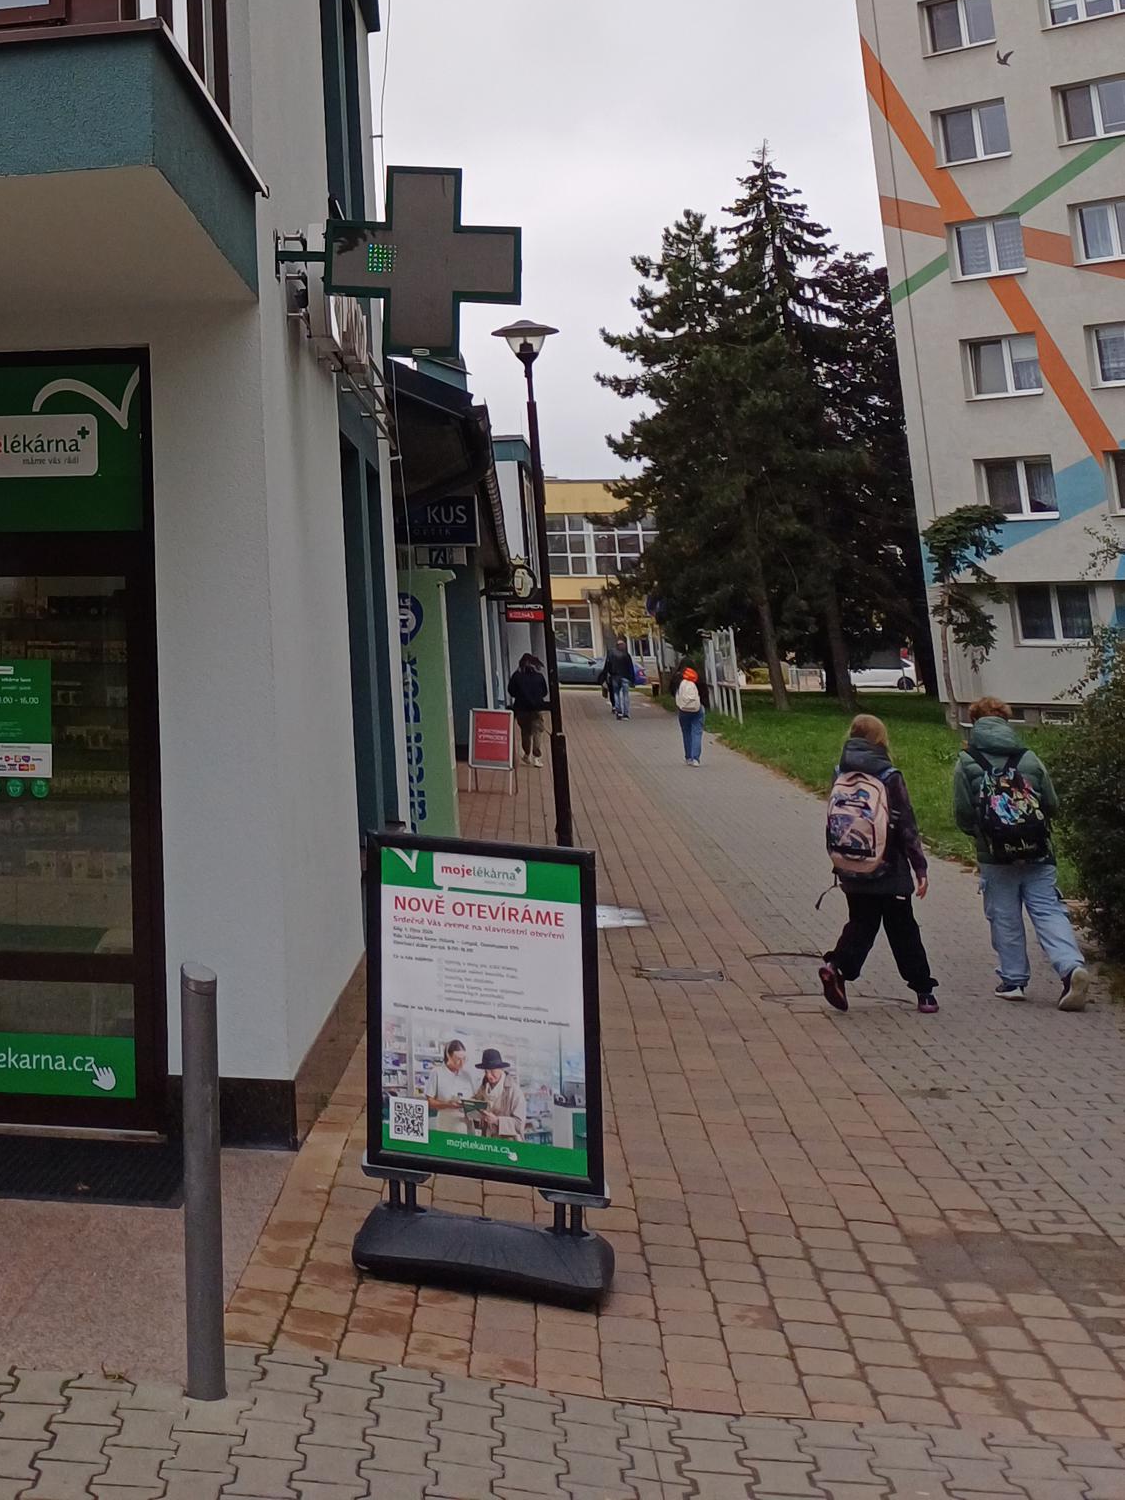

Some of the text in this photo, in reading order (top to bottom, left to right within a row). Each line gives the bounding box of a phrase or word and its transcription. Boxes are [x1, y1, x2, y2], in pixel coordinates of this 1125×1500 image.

[426, 504, 468, 524] KUS
[441, 864, 517, 881] mojelékárna
[393, 894, 565, 927] NOVĚ OTEVÍRÁME
